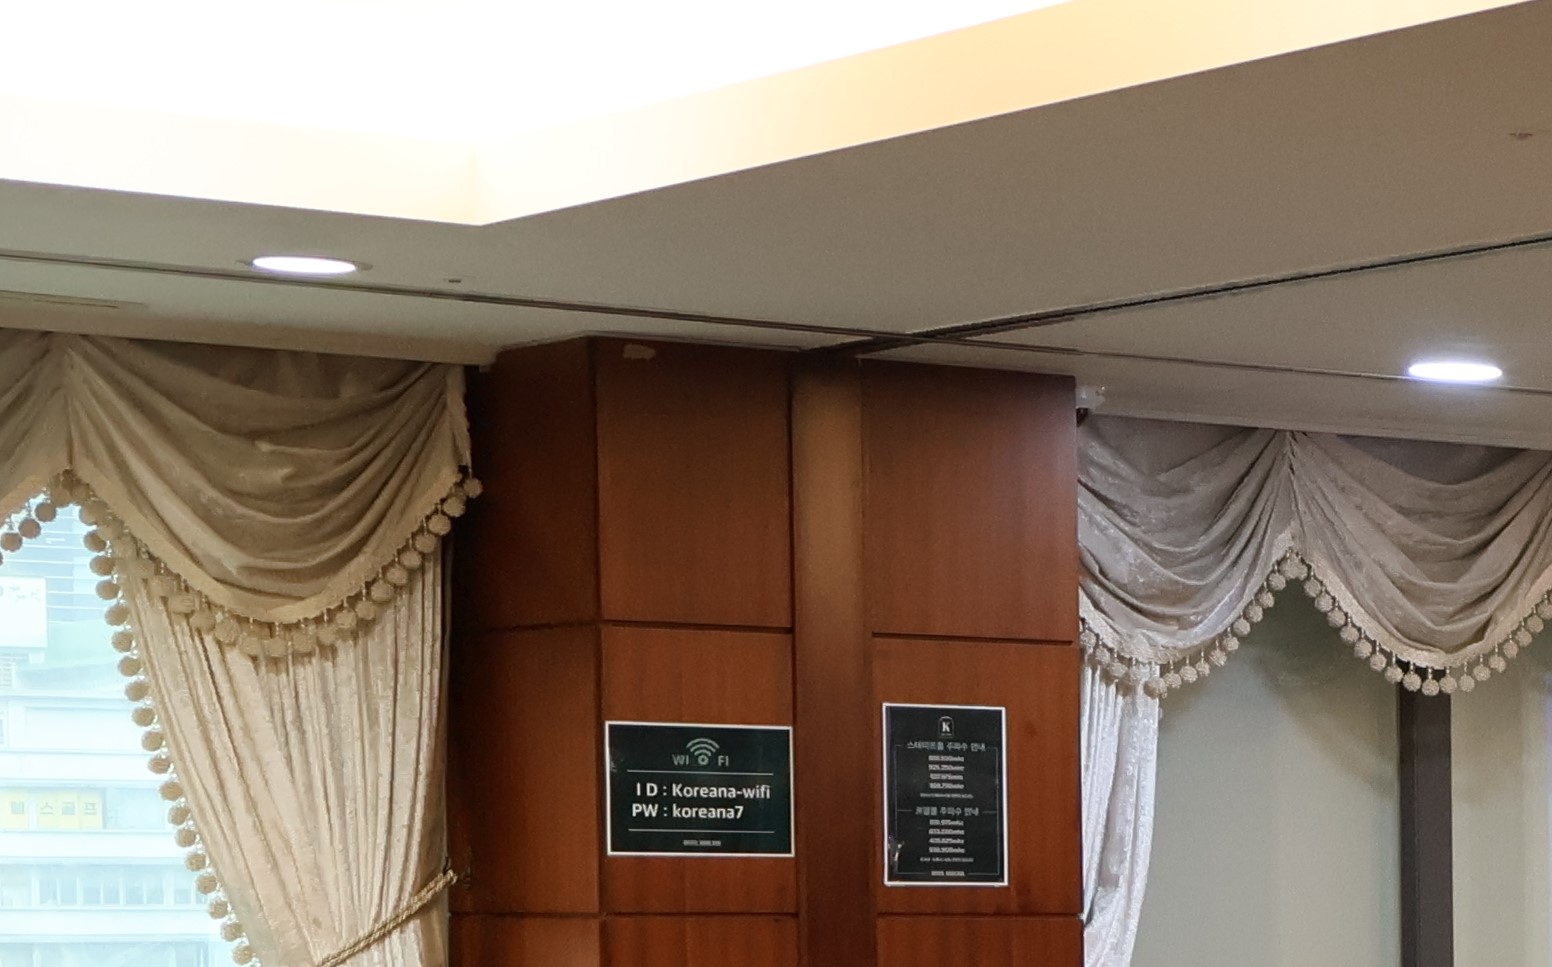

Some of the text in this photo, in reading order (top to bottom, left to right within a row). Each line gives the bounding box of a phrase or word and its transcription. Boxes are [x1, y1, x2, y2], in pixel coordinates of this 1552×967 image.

[672, 754, 730, 767] WI FI
[672, 783, 772, 799] Koreana-wifi
[632, 803, 659, 817] PW
[672, 804, 744, 819] koreana7
